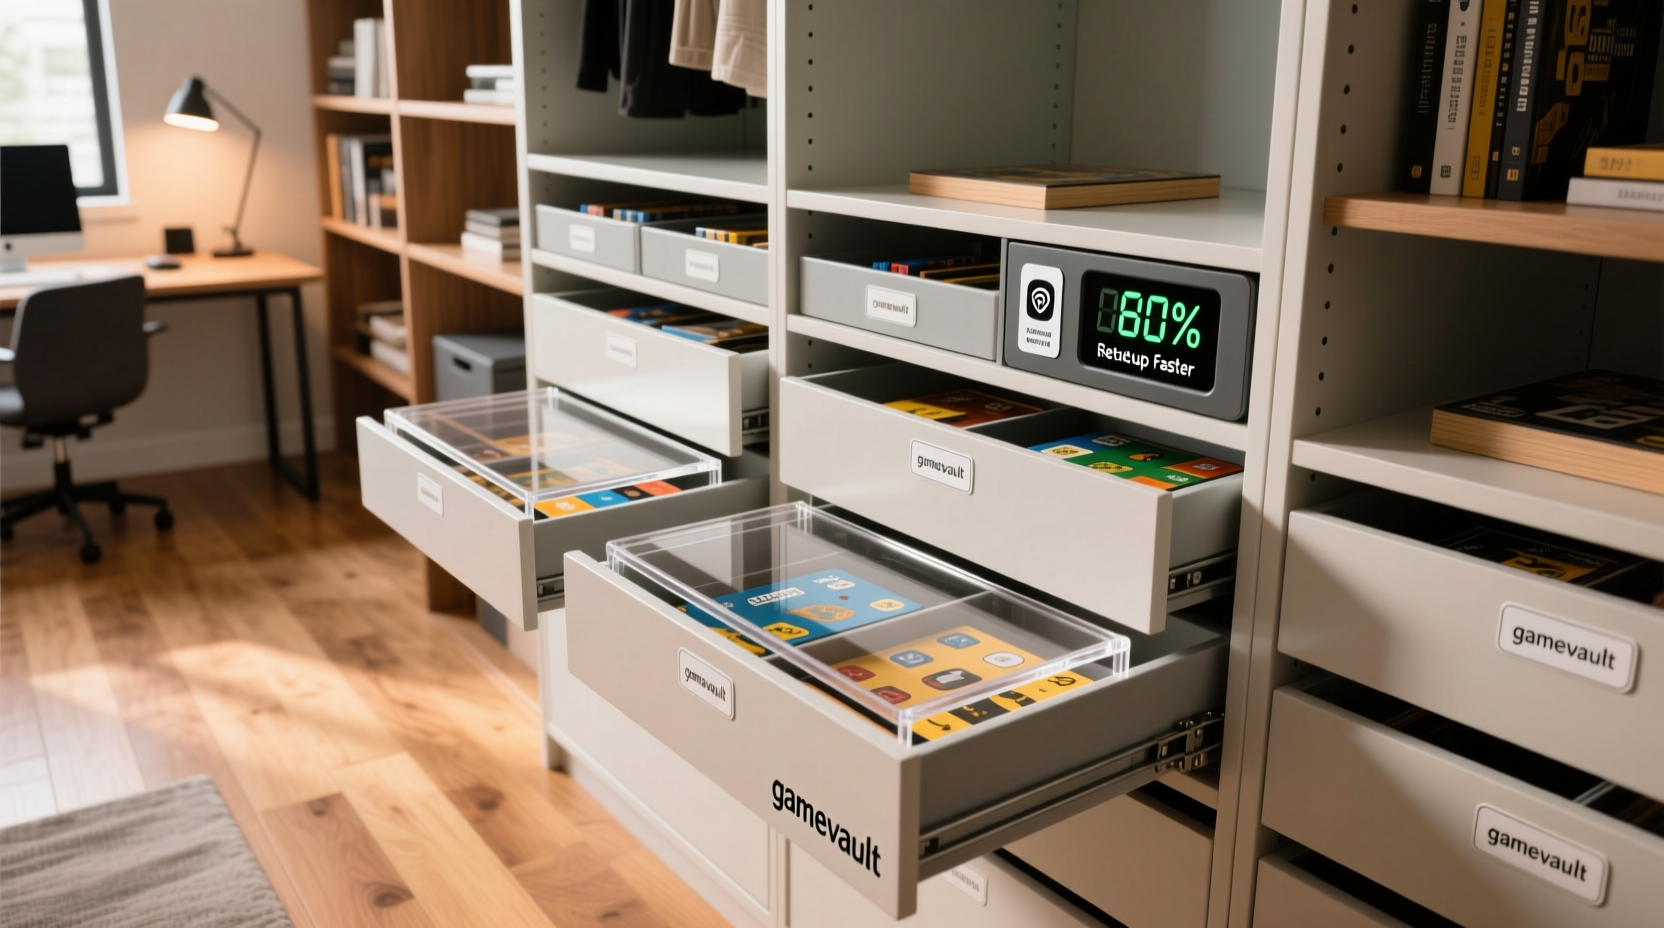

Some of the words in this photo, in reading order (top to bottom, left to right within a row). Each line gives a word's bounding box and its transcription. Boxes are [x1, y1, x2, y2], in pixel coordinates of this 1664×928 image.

[1153, 353, 1196, 377] Faster
[1512, 624, 1617, 671] gamevault
[771, 779, 882, 878] gamevault
[1487, 825, 1588, 883] gamevault
